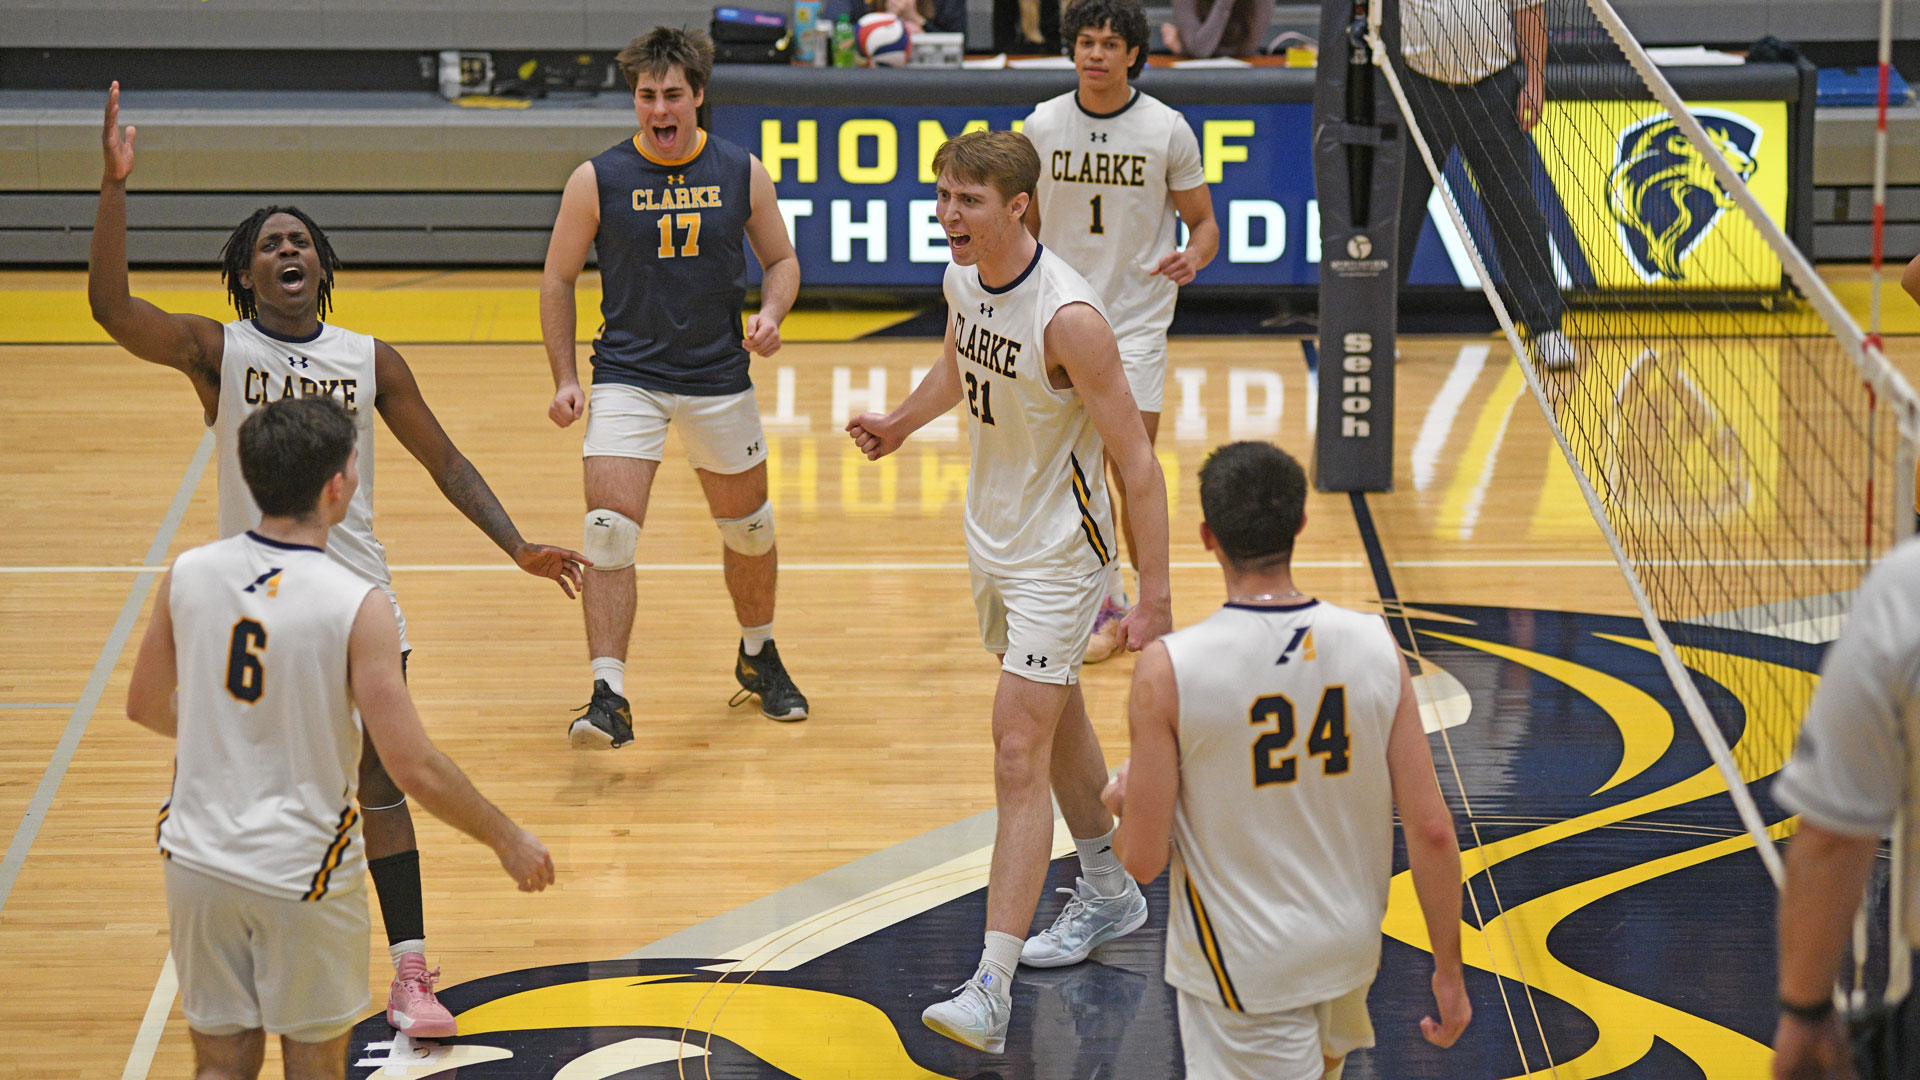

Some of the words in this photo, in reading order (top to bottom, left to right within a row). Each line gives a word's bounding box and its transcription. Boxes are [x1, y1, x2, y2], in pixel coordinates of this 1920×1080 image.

[1051, 149, 1146, 187] CLARKE
[632, 186, 722, 211] CLARKE
[1090, 194, 1104, 235] 1
[657, 213, 701, 259] 17
[955, 311, 1022, 379] CLARKE
[965, 371, 996, 426] 21
[224, 616, 268, 706] 6
[1249, 684, 1352, 790] 24
